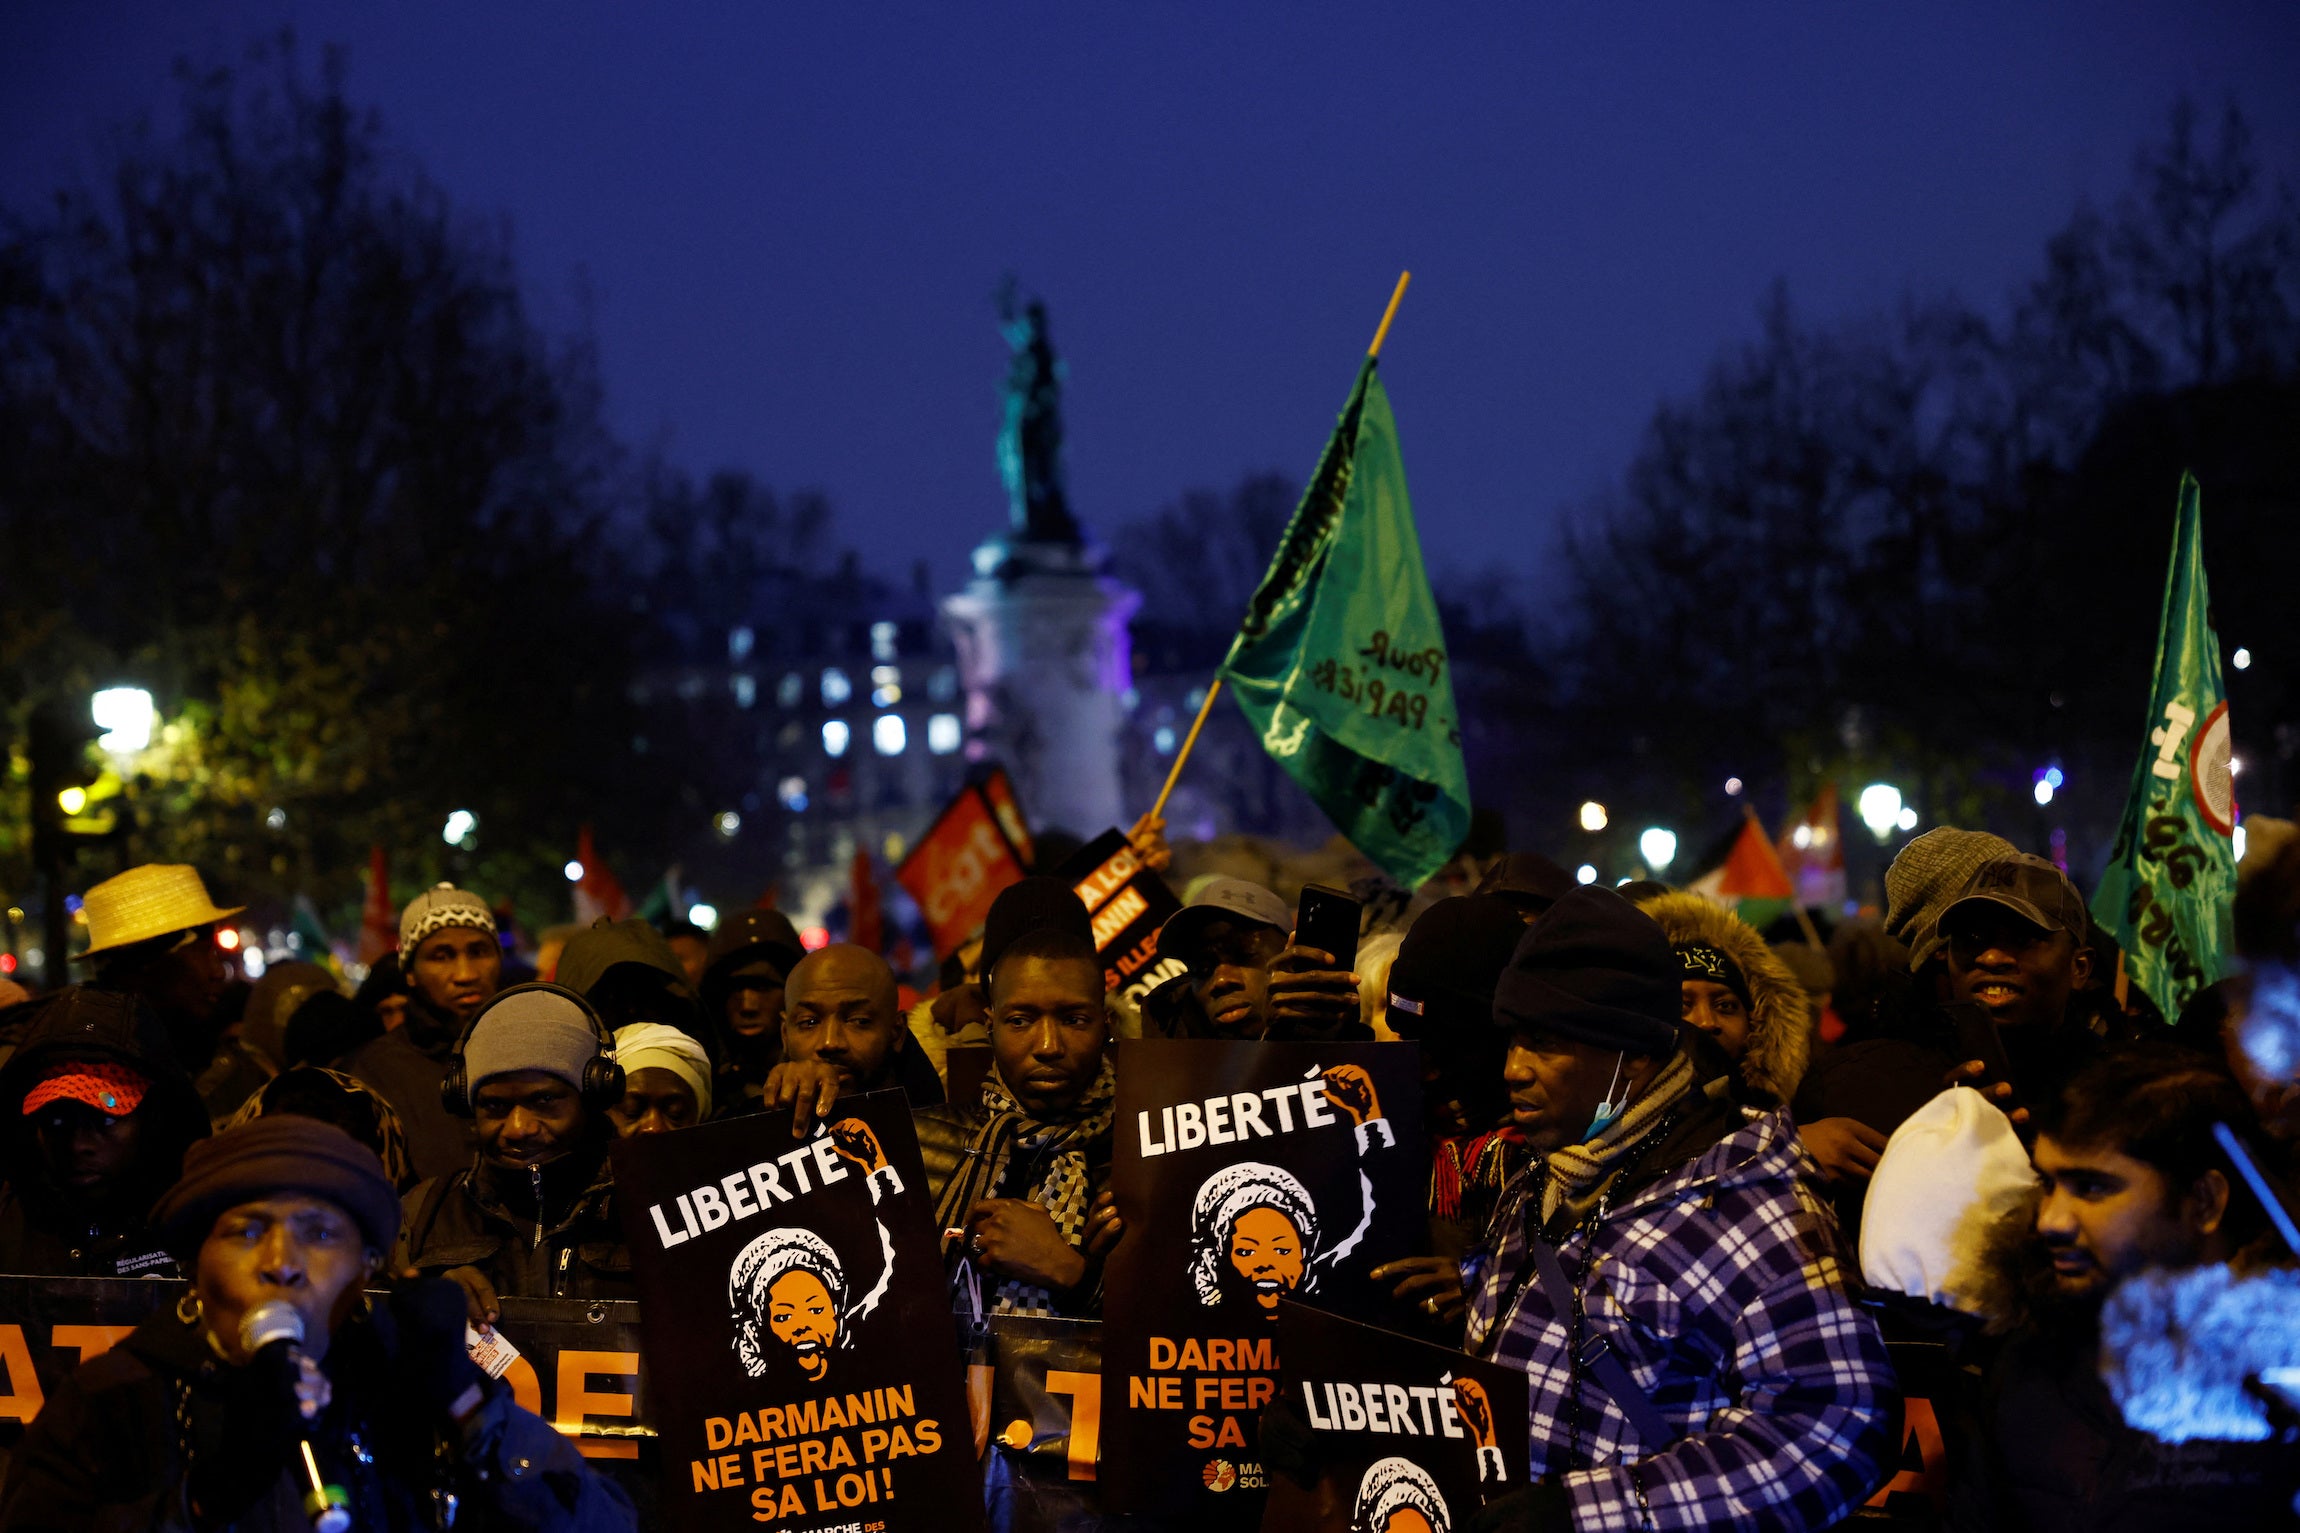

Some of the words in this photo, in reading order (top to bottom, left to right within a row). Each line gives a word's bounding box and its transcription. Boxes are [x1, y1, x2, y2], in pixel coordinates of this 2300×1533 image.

[1138, 1063, 1337, 1159] LIBERTÉ
[649, 1122, 849, 1250] LIBERTÉ
[1149, 1336, 1281, 1372] DARM
[1129, 1375, 1184, 1410] NE
[1195, 1376, 1286, 1410] FER
[1301, 1370, 1465, 1439] LIBERTÉ
[704, 1384, 917, 1451] DARMANIN
[1187, 1414, 1248, 1450] SA
[690, 1454, 745, 1494] NE
[752, 1435, 858, 1483] FERA
[861, 1418, 943, 1464] PAS
[1239, 1476, 1269, 1489] SOL
[750, 1483, 807, 1523] SA
[864, 1520, 886, 1532] DES
